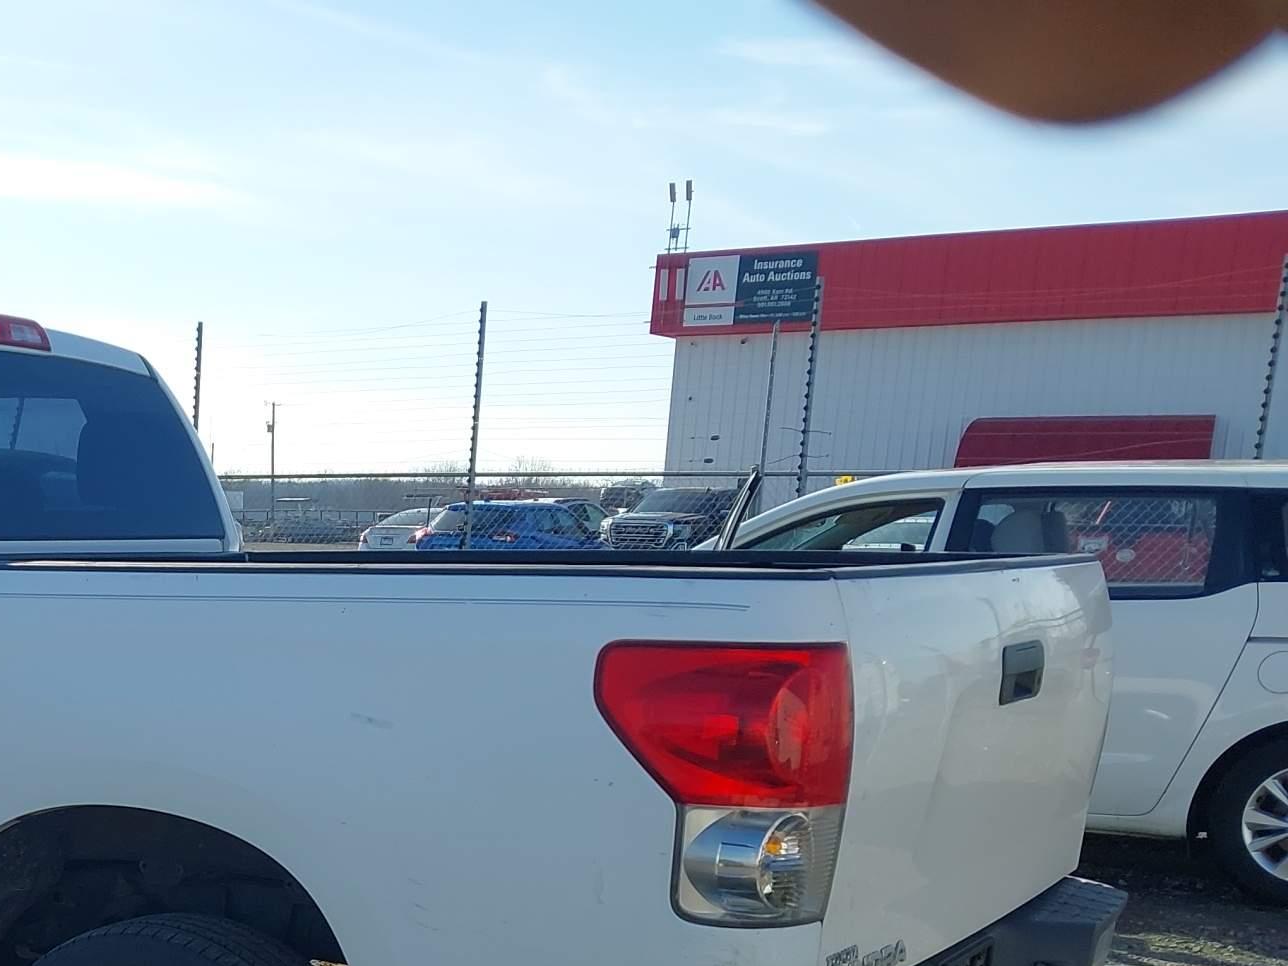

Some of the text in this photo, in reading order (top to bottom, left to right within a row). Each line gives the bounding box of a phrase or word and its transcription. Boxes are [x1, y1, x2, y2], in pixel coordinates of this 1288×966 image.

[753, 259, 803, 269] Insurance
[743, 269, 812, 283] Auto Auctions
